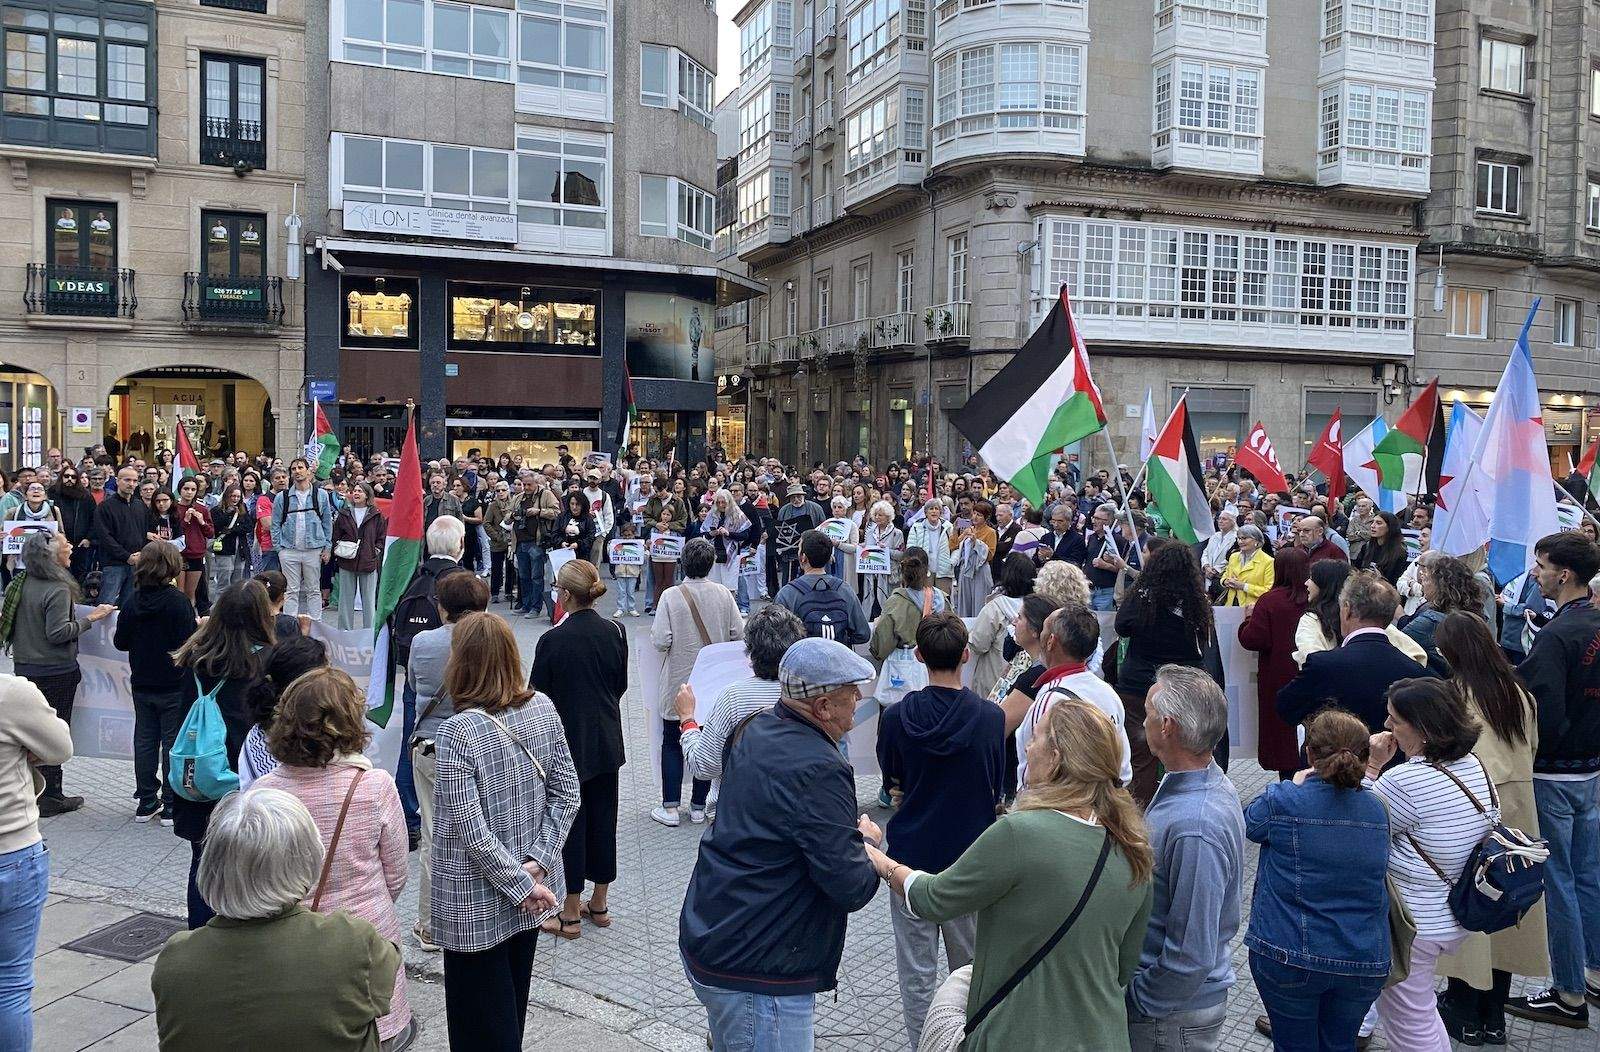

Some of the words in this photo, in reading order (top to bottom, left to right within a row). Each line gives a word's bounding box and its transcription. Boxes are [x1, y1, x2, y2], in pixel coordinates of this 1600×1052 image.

[455, 212, 478, 221] dental
[56, 281, 104, 293] YDEAS
[78, 370, 86, 381] 3
[172, 394, 204, 402] ACUA
